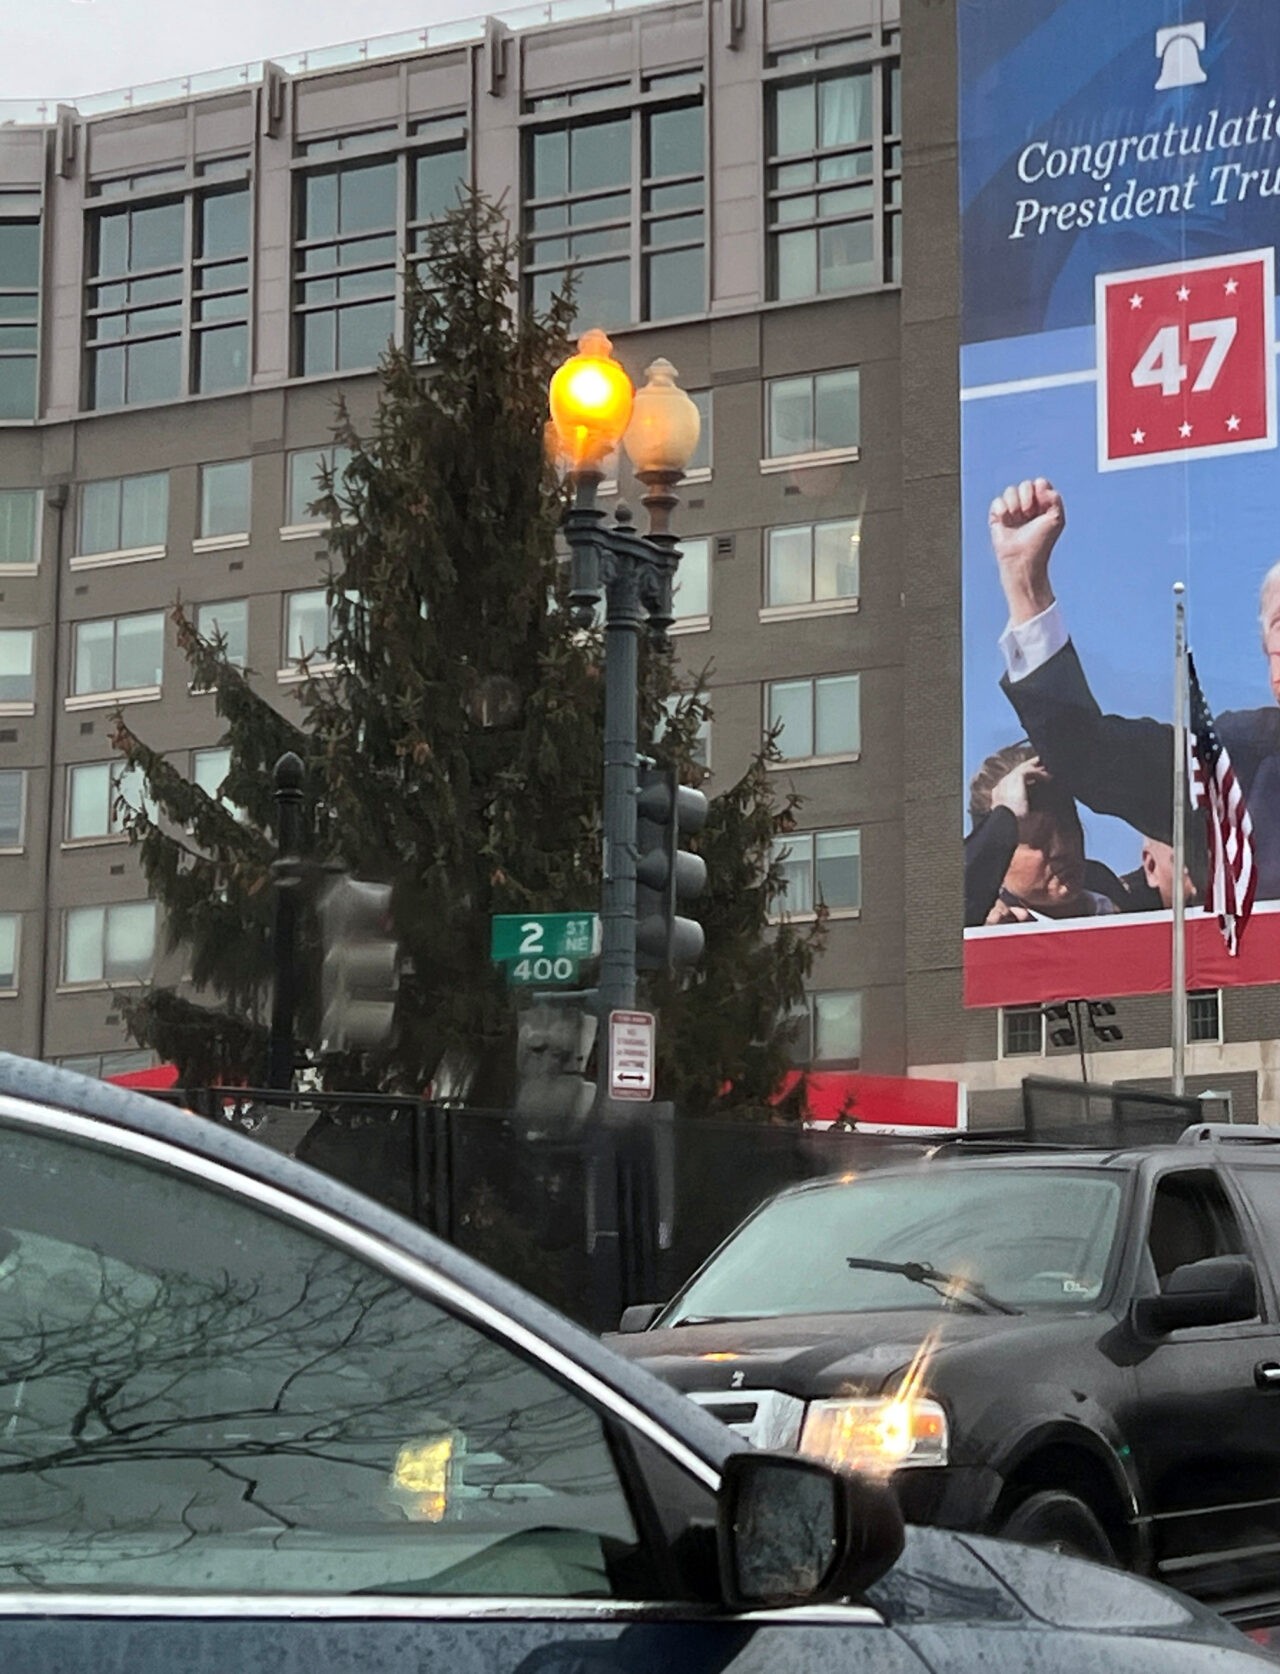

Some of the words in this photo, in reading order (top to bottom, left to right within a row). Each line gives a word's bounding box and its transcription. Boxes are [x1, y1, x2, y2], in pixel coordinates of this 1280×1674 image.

[1009, 180, 1199, 239] President
[1131, 316, 1238, 396] 47
[520, 922, 544, 953] 2
[566, 921, 588, 934] ST
[566, 938, 588, 951] NE
[513, 958, 573, 980] 400
